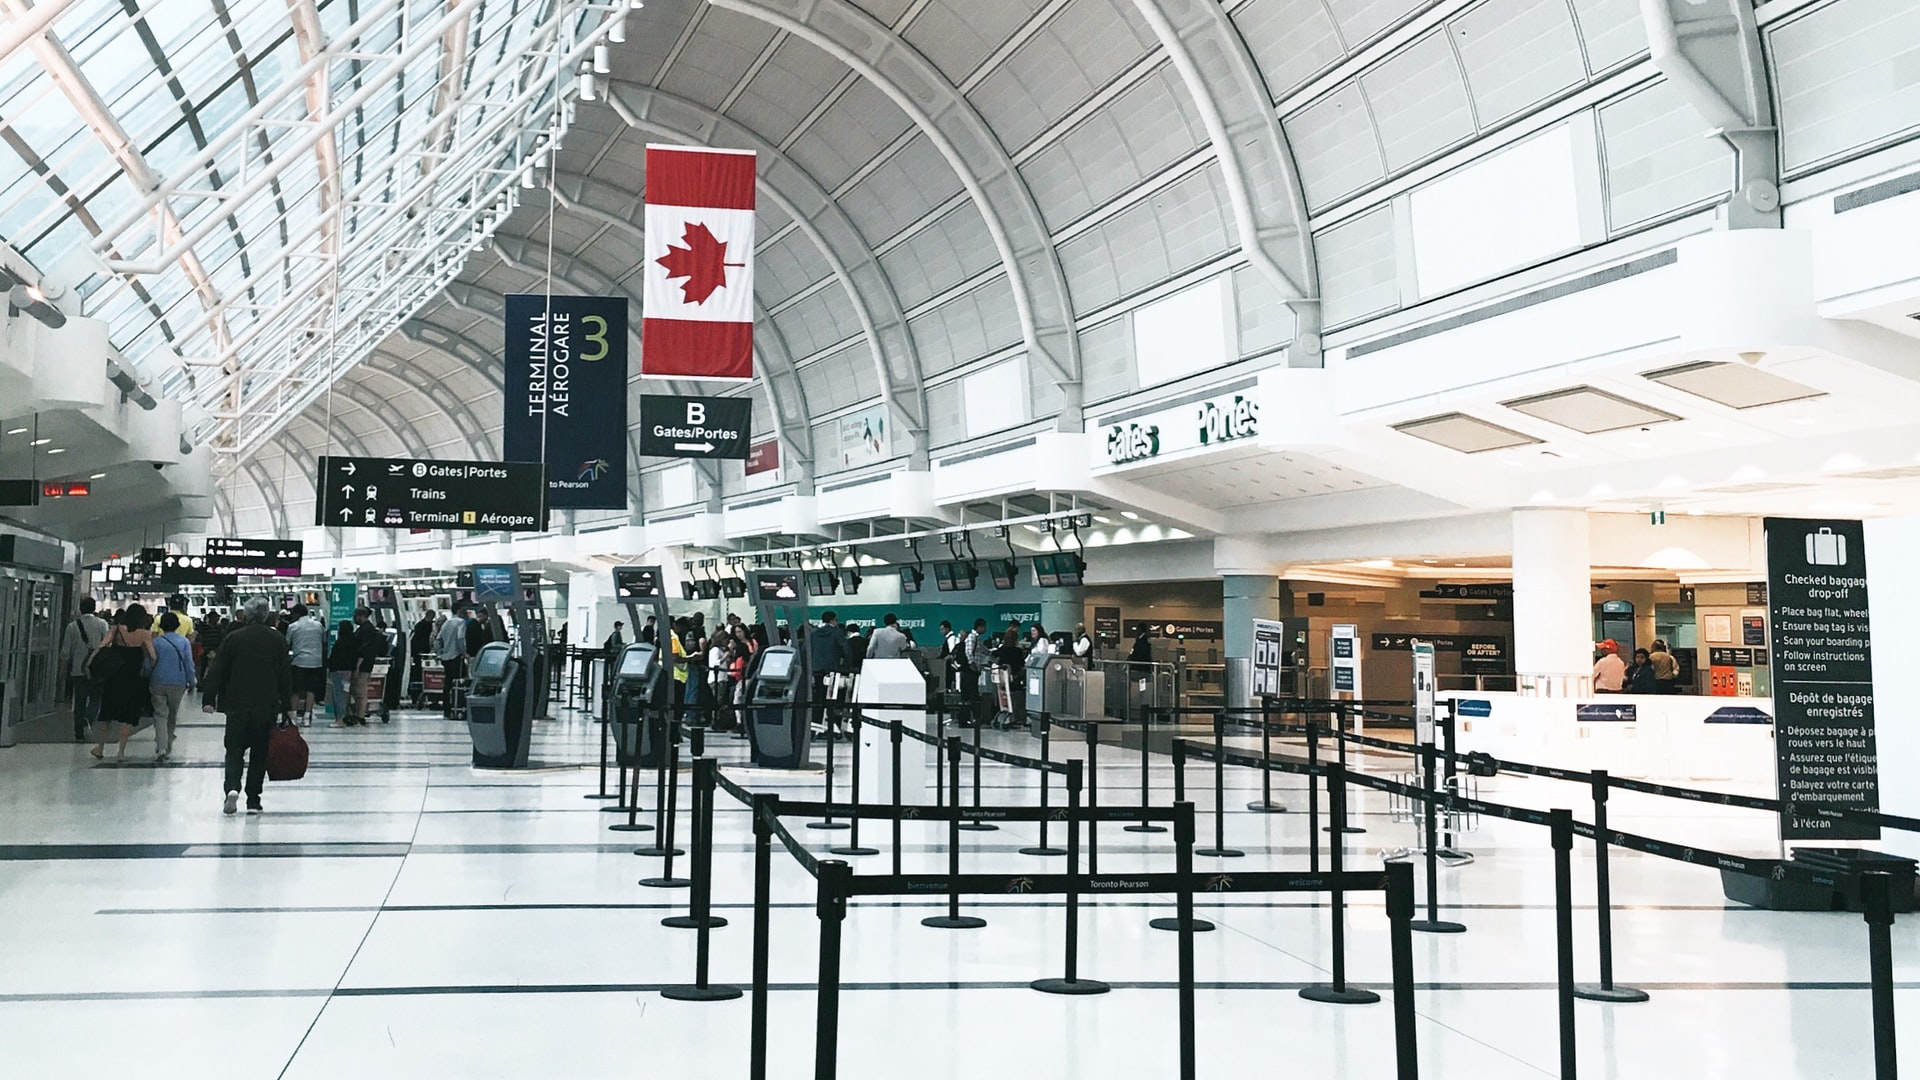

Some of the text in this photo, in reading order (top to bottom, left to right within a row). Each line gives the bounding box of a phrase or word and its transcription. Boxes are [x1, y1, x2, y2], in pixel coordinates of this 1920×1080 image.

[579, 314, 610, 362] 3
[529, 312, 546, 417] TERMINAL
[552, 312, 570, 417] AÉROGARE
[686, 402, 707, 426] B
[653, 424, 738, 441] Gates/Portes
[1106, 423, 1160, 466] Gates
[430, 466, 463, 477] Gates
[469, 467, 508, 479] Portes
[558, 480, 589, 489] Pearson
[410, 488, 447, 500] Trains
[409, 511, 459, 523] Terminal
[480, 512, 534, 526] Aérogare
[1785, 574, 1867, 588] Checked baggag
[1808, 587, 1849, 599] drop-off
[1781, 606, 1805, 617] Place
[1807, 607, 1822, 618] bag
[1824, 607, 1842, 618] flat,
[1782, 621, 1812, 631] Ensure
[1814, 622, 1829, 633] bag
[1831, 623, 1845, 634] tag
[1847, 623, 1855, 632] is
[1783, 635, 1804, 646] Scan
[1805, 637, 1824, 648] your
[1826, 637, 1863, 648] boarding
[1783, 650, 1865, 661] Follow instructions
[1784, 663, 1827, 671] on screen
[1789, 691, 1820, 705] Dépôt
[1821, 693, 1835, 704] de
[1806, 706, 1864, 719] enregistrés
[1787, 725, 1875, 738] Déposez bagage à p
[1788, 739, 1866, 748] roues vers le haut
[1789, 752, 1825, 762] Assurez
[1826, 754, 1843, 764] que
[1789, 765, 1802, 775] de
[1803, 765, 1835, 776] bagage
[1837, 766, 1851, 775] est
[1790, 780, 1875, 791] Balayez votre carte
[1791, 791, 1865, 802] d'embarquement
[962, 810, 1006, 818] Toronto Pearson
[1792, 817, 1831, 829] à l'écran
[907, 879, 949, 891] bienvenue
[1090, 880, 1149, 889] Toronto Pearson
[1288, 878, 1324, 887] welcome
